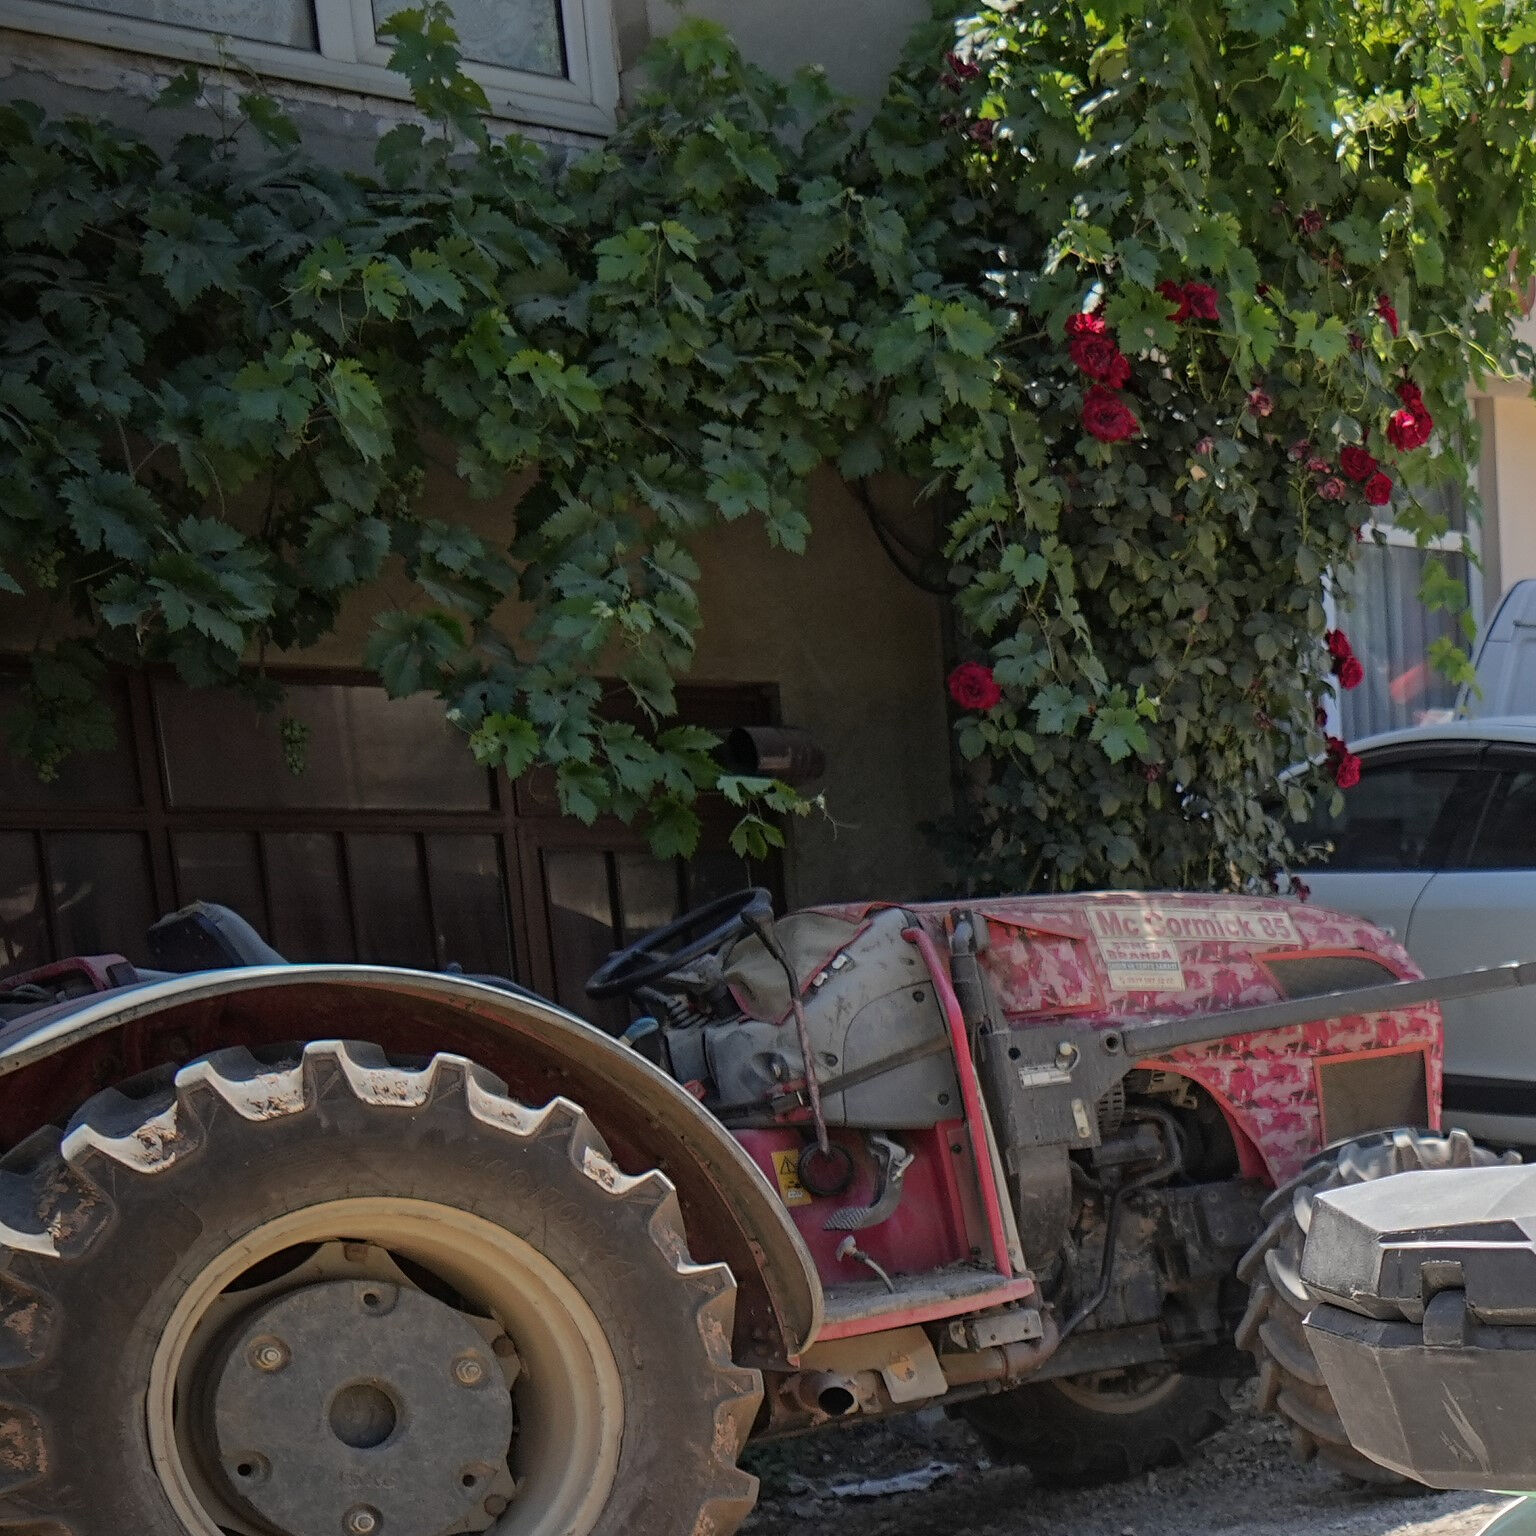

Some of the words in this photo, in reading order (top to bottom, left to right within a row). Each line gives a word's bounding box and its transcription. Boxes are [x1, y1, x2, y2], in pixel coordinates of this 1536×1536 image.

[1096, 910, 1140, 936] Mc
[1143, 910, 1256, 938] Cormick
[1257, 916, 1292, 939] 85
